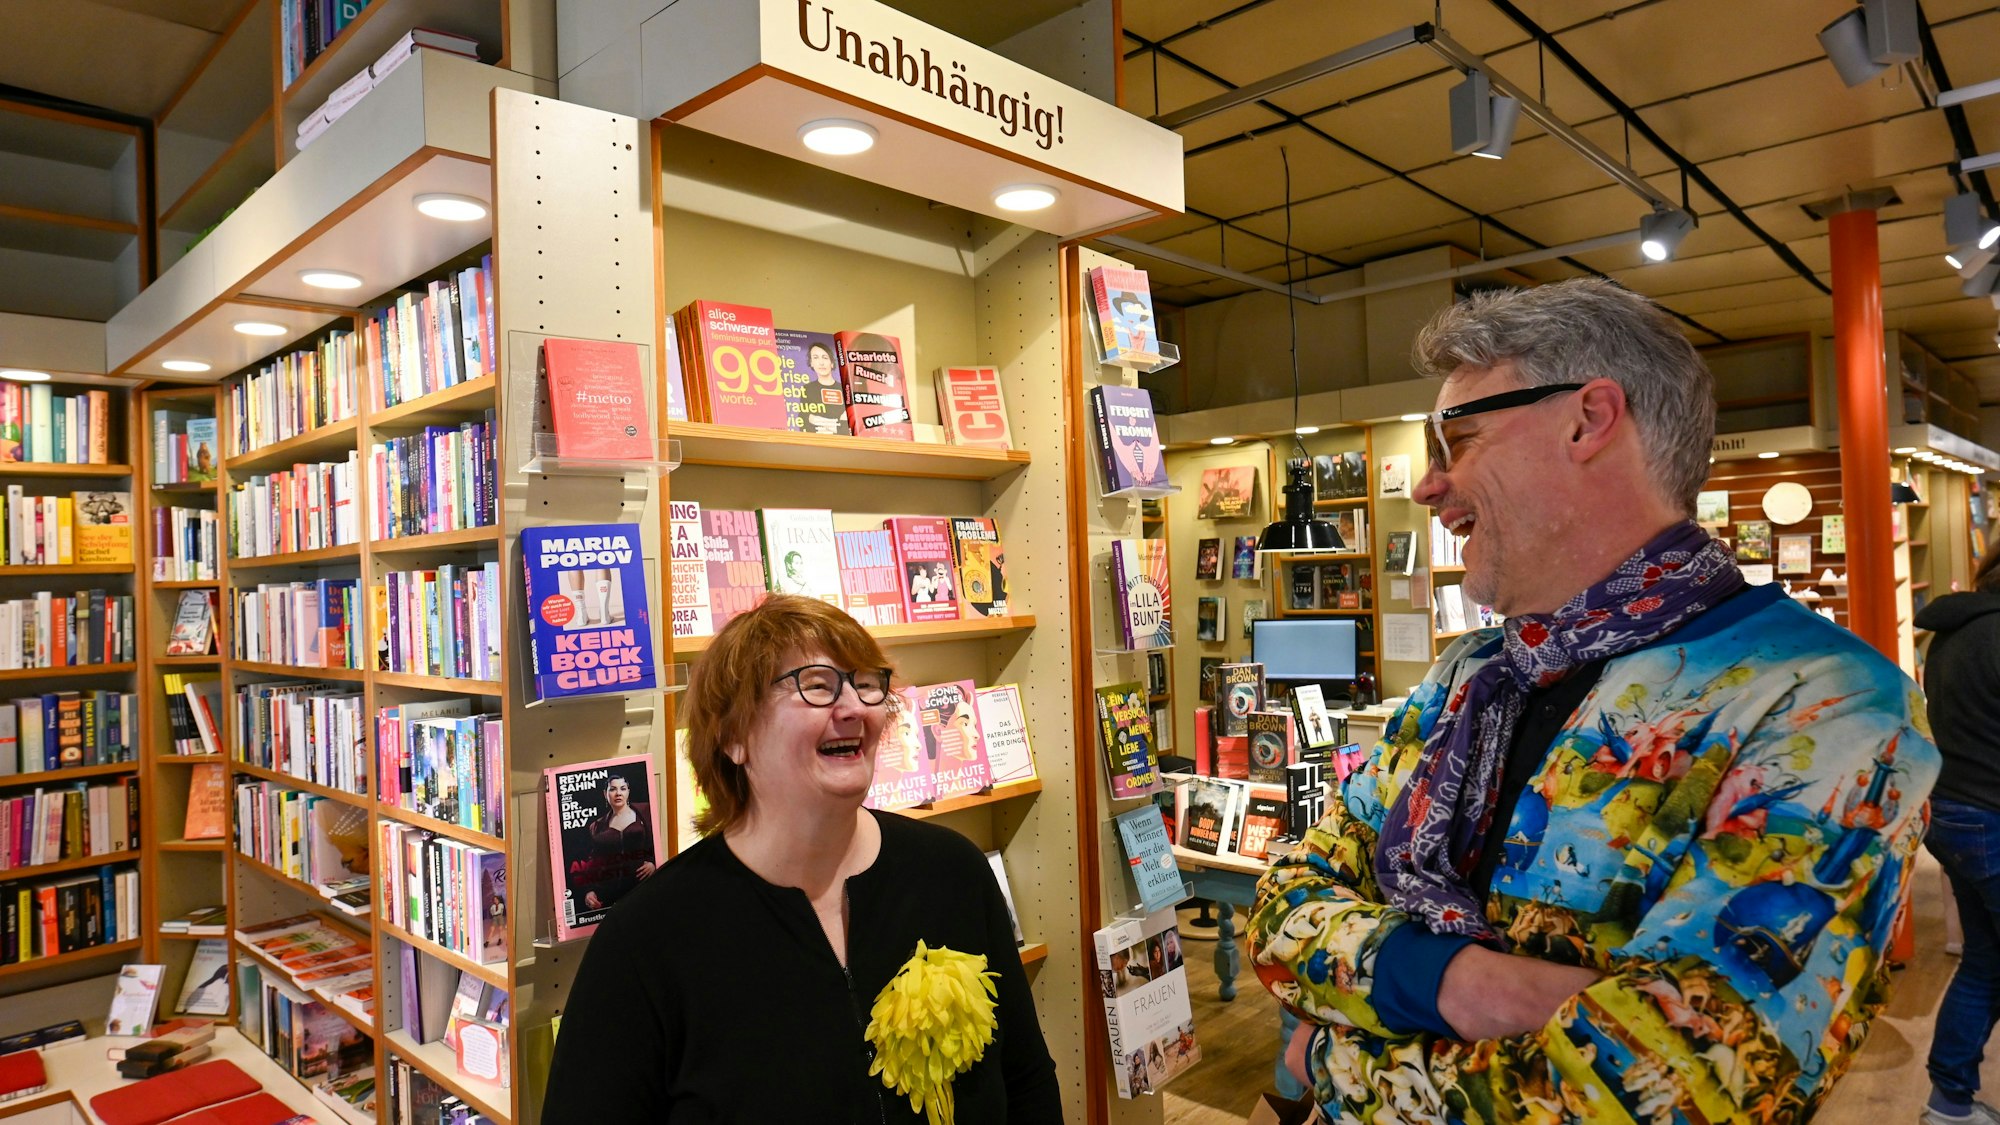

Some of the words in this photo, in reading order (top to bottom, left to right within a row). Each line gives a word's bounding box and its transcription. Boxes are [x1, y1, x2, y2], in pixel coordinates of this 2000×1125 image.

[798, 0, 1064, 150] Unabhängig!
[708, 308, 737, 321] alice
[709, 320, 770, 336] schwarzer
[711, 332, 757, 344] feminismus
[848, 351, 897, 363] Charlotte
[712, 345, 784, 396] 99
[576, 390, 632, 405] #metoo
[720, 394, 757, 405] worte.
[784, 399, 827, 413] rauen
[1109, 405, 1150, 419] FEUCHT
[1115, 425, 1153, 437] FROMM
[710, 511, 760, 536] FRAU
[912, 525, 934, 533] GUTE
[955, 522, 985, 531] FRAUEN
[786, 528, 831, 544] IRAN
[904, 534, 944, 542] FREUNDIN
[958, 530, 997, 540] PROBLEME
[541, 536, 631, 553] MARIA
[704, 536, 729, 549] Shila
[902, 542, 948, 551] SCHLECHTE
[540, 550, 632, 568] POPOV
[907, 550, 946, 559] FREUNDIN
[726, 561, 766, 587] UND
[1127, 574, 1164, 594] MITTENDR
[1135, 593, 1160, 608] LILA
[1133, 610, 1161, 626] BUNT
[555, 629, 635, 652] KEIN
[551, 647, 643, 672] BOCK
[557, 665, 642, 689] CLUB
[1226, 673, 1258, 684] BROWN
[1232, 667, 1251, 676] DAN
[927, 685, 958, 698] LEONIE
[925, 694, 963, 708] SCHÖLER
[1110, 693, 1125, 705] EIN
[421, 707, 461, 718] MELANIE
[1112, 707, 1148, 722] VERSUCH,
[1257, 715, 1279, 723] DAN
[999, 720, 1012, 728] DAS
[1128, 723, 1150, 736] MEINE
[1249, 722, 1286, 732] BROWN
[992, 741, 1005, 749] DER
[1006, 737, 1025, 747] DINGE
[1119, 741, 1140, 756] LIEBE
[1146, 754, 1157, 766] ZU
[559, 770, 609, 785] REYHAN
[931, 764, 985, 785] BEKLAUTE
[1125, 772, 1157, 789] ORDNEN
[560, 780, 597, 795] ŞAHIN
[868, 775, 927, 798] BEKLAUTE
[936, 777, 983, 796] FRAUEN
[561, 801, 582, 812] DR.
[874, 790, 924, 809] FRAUEN
[562, 808, 598, 821] BITCH
[564, 818, 589, 830] RAY
[1129, 818, 1153, 830] Wenn
[1198, 817, 1215, 830] BODY
[1134, 829, 1164, 845] Männer
[1247, 823, 1279, 839] WEST
[1139, 850, 1152, 859] mir
[1154, 843, 1165, 854] die
[1244, 836, 1266, 852] EN
[1141, 860, 1161, 872] Welt
[1147, 869, 1179, 888] erklären
[1133, 982, 1176, 1016] FRAUEN
[1106, 1005, 1125, 1066] FRAUEN
